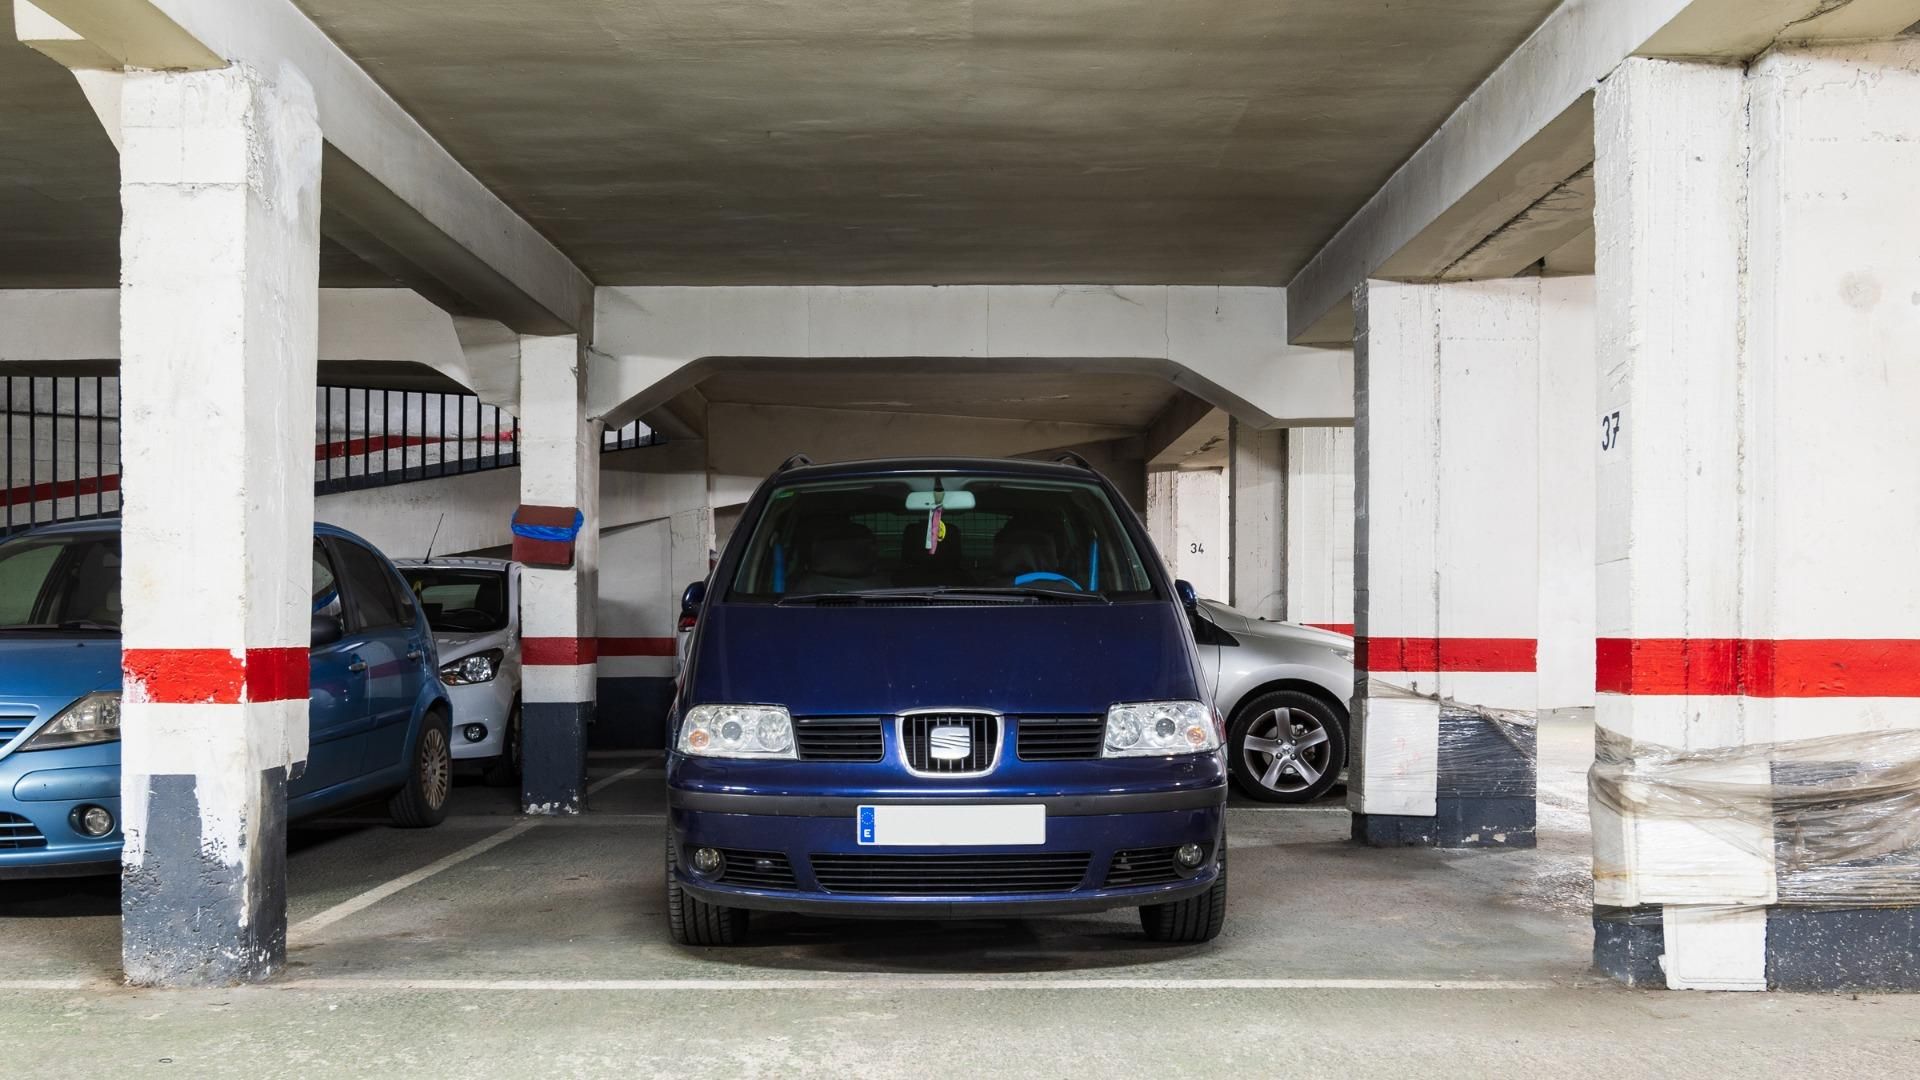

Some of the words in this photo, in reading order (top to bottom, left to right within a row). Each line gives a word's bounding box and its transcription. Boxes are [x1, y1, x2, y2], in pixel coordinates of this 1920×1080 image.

[1602, 411, 1620, 451] 37
[1190, 543, 1204, 554] 34
[864, 829, 871, 838] E
